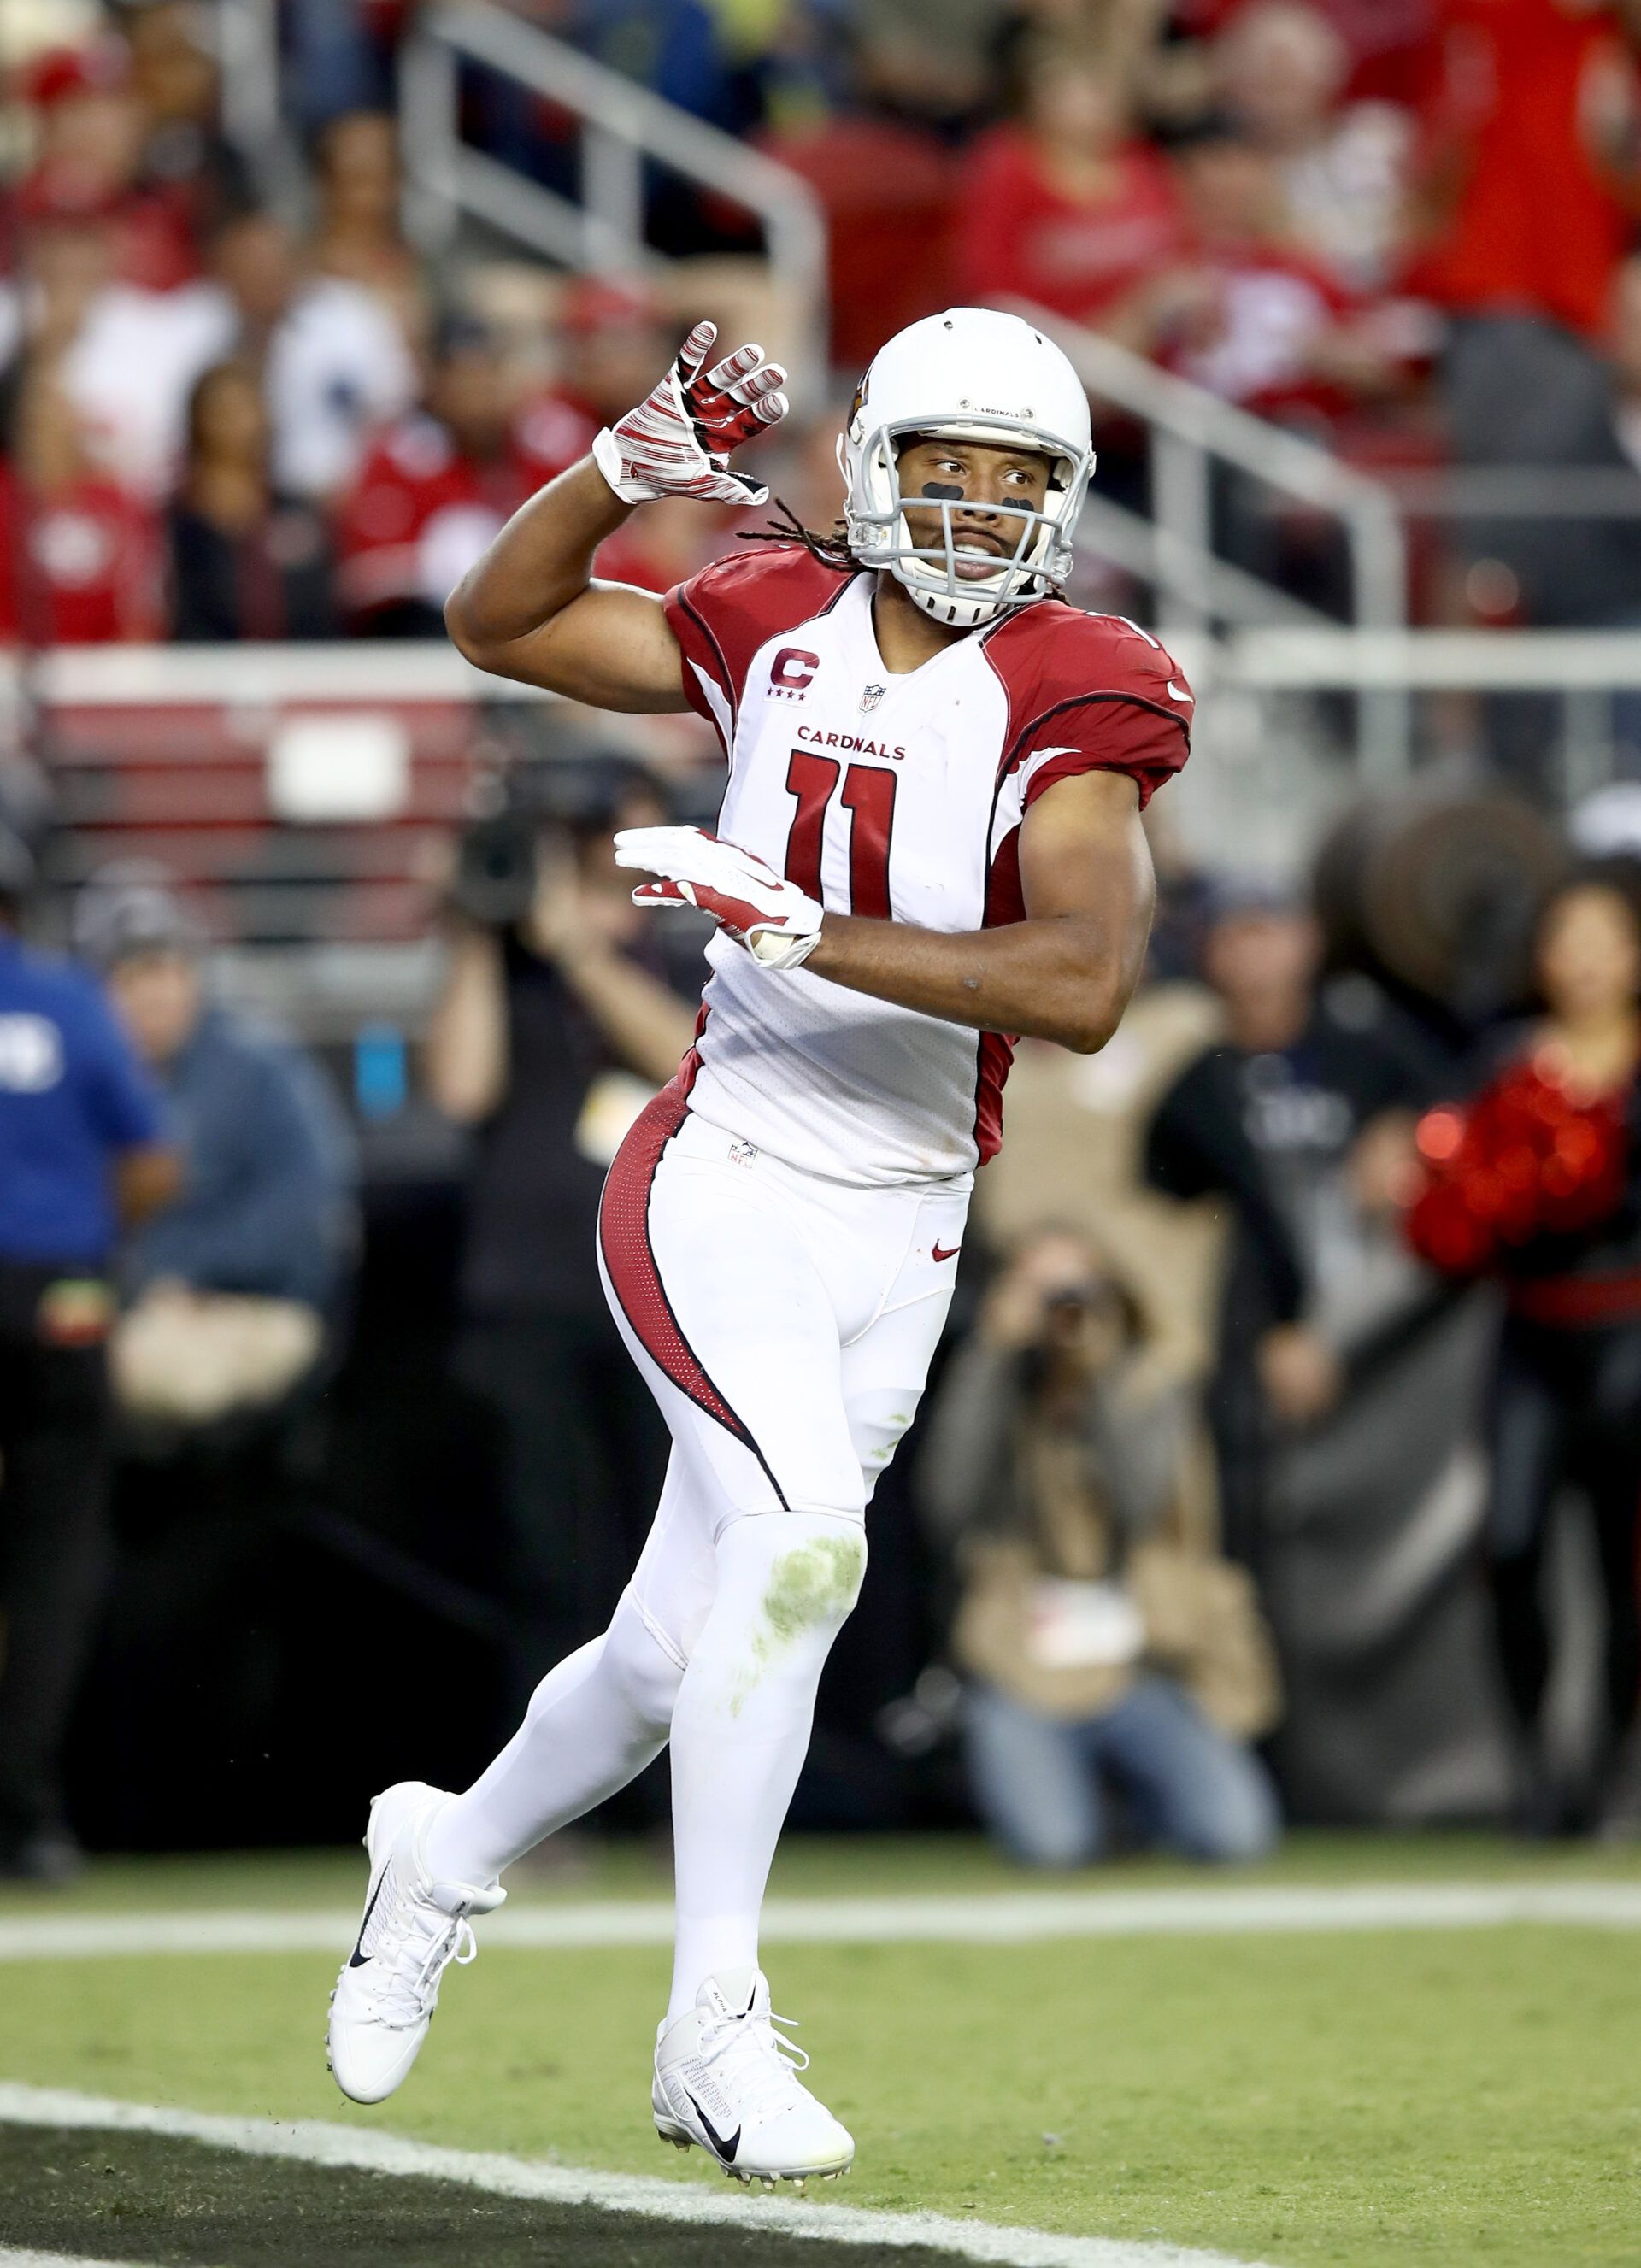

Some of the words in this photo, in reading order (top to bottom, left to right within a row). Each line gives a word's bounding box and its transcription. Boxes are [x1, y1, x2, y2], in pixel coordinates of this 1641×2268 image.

[770, 647, 820, 690] C
[861, 696, 878, 710] NFL
[797, 726, 906, 761] CARDNALS
[784, 749, 897, 921] 11
